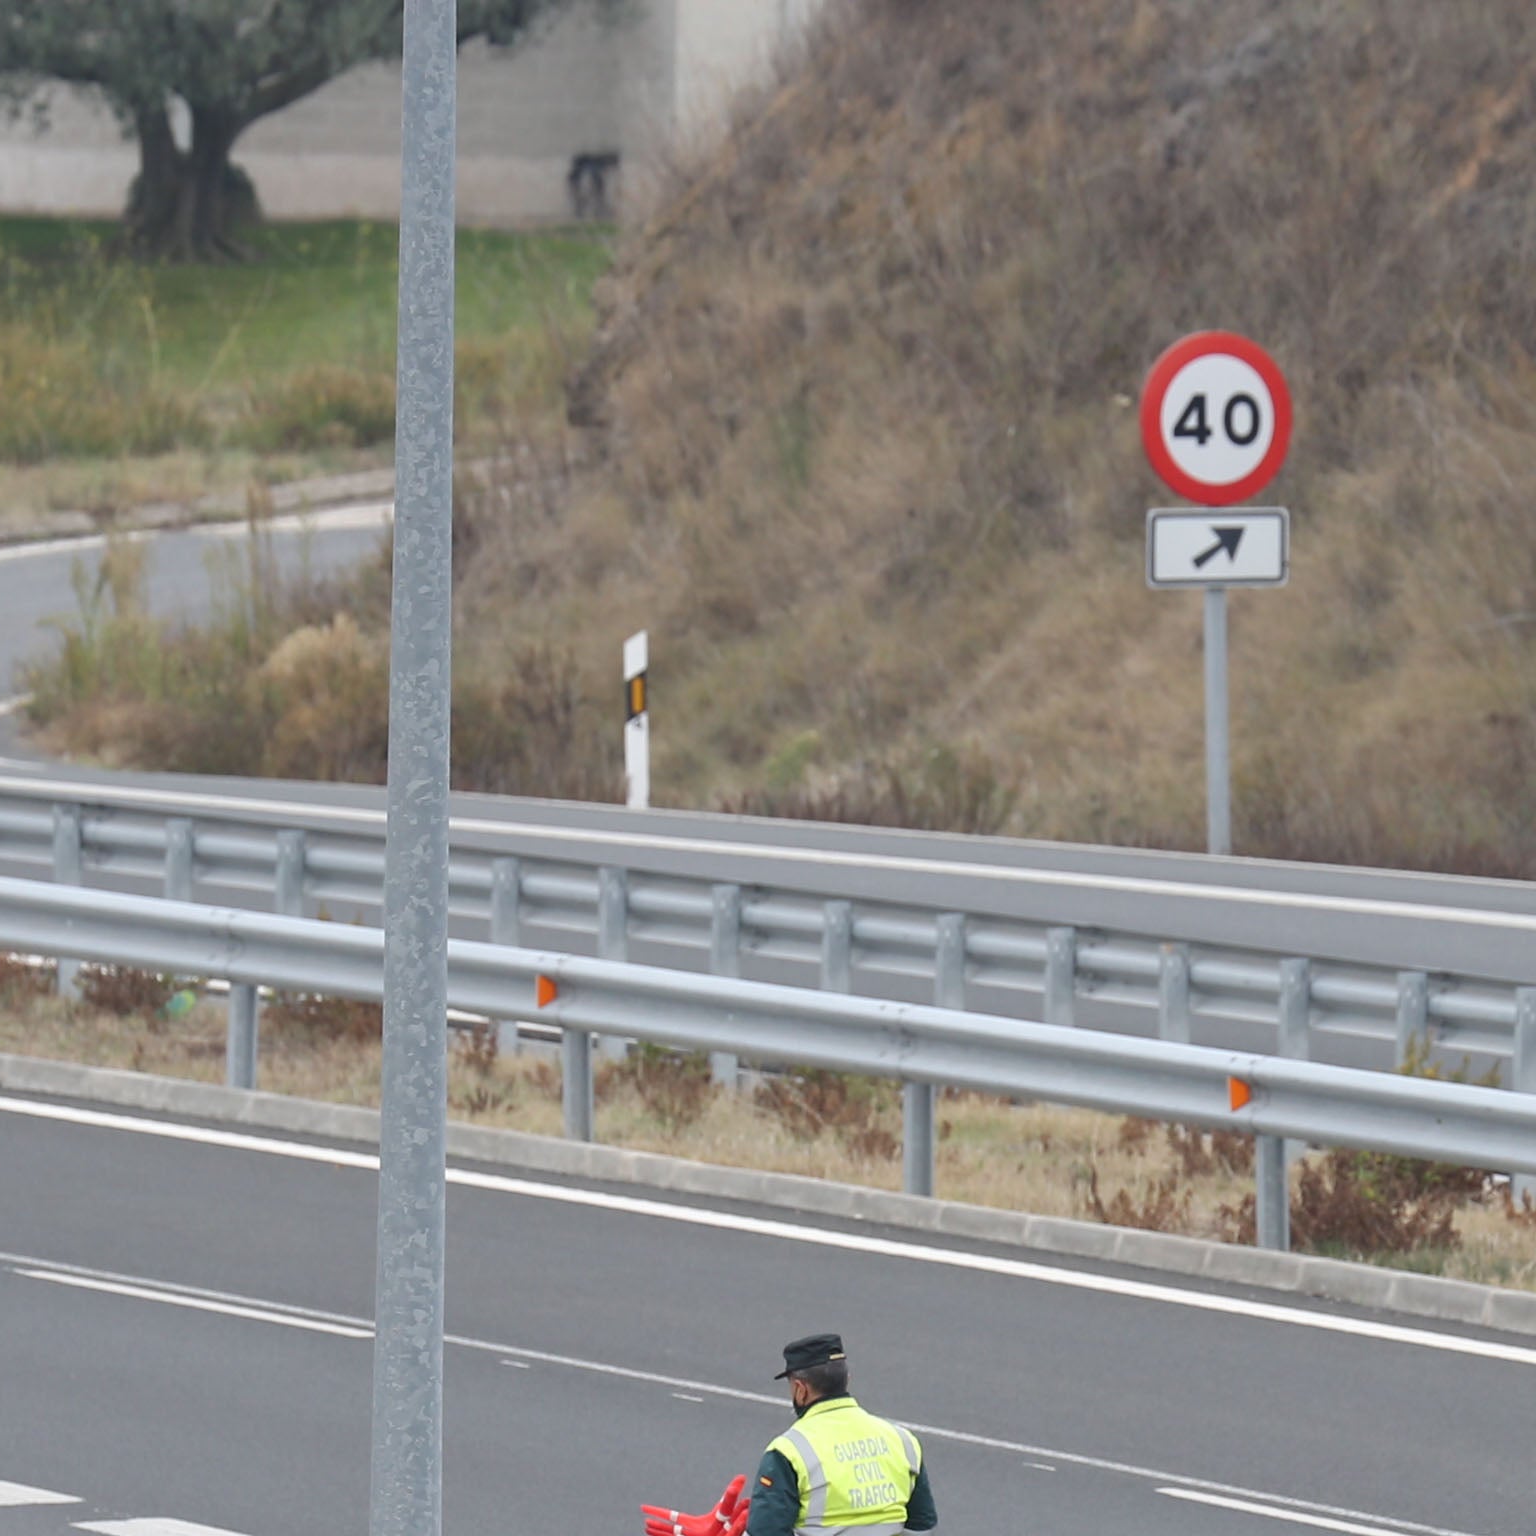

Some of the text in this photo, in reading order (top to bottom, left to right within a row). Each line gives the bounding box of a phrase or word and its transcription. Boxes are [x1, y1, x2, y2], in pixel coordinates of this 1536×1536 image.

[1173, 393, 1260, 445] 40
[833, 1436, 891, 1463] GUARDIA
[854, 1461, 885, 1484] CIVIL
[848, 1482, 897, 1509] TRAFICO
